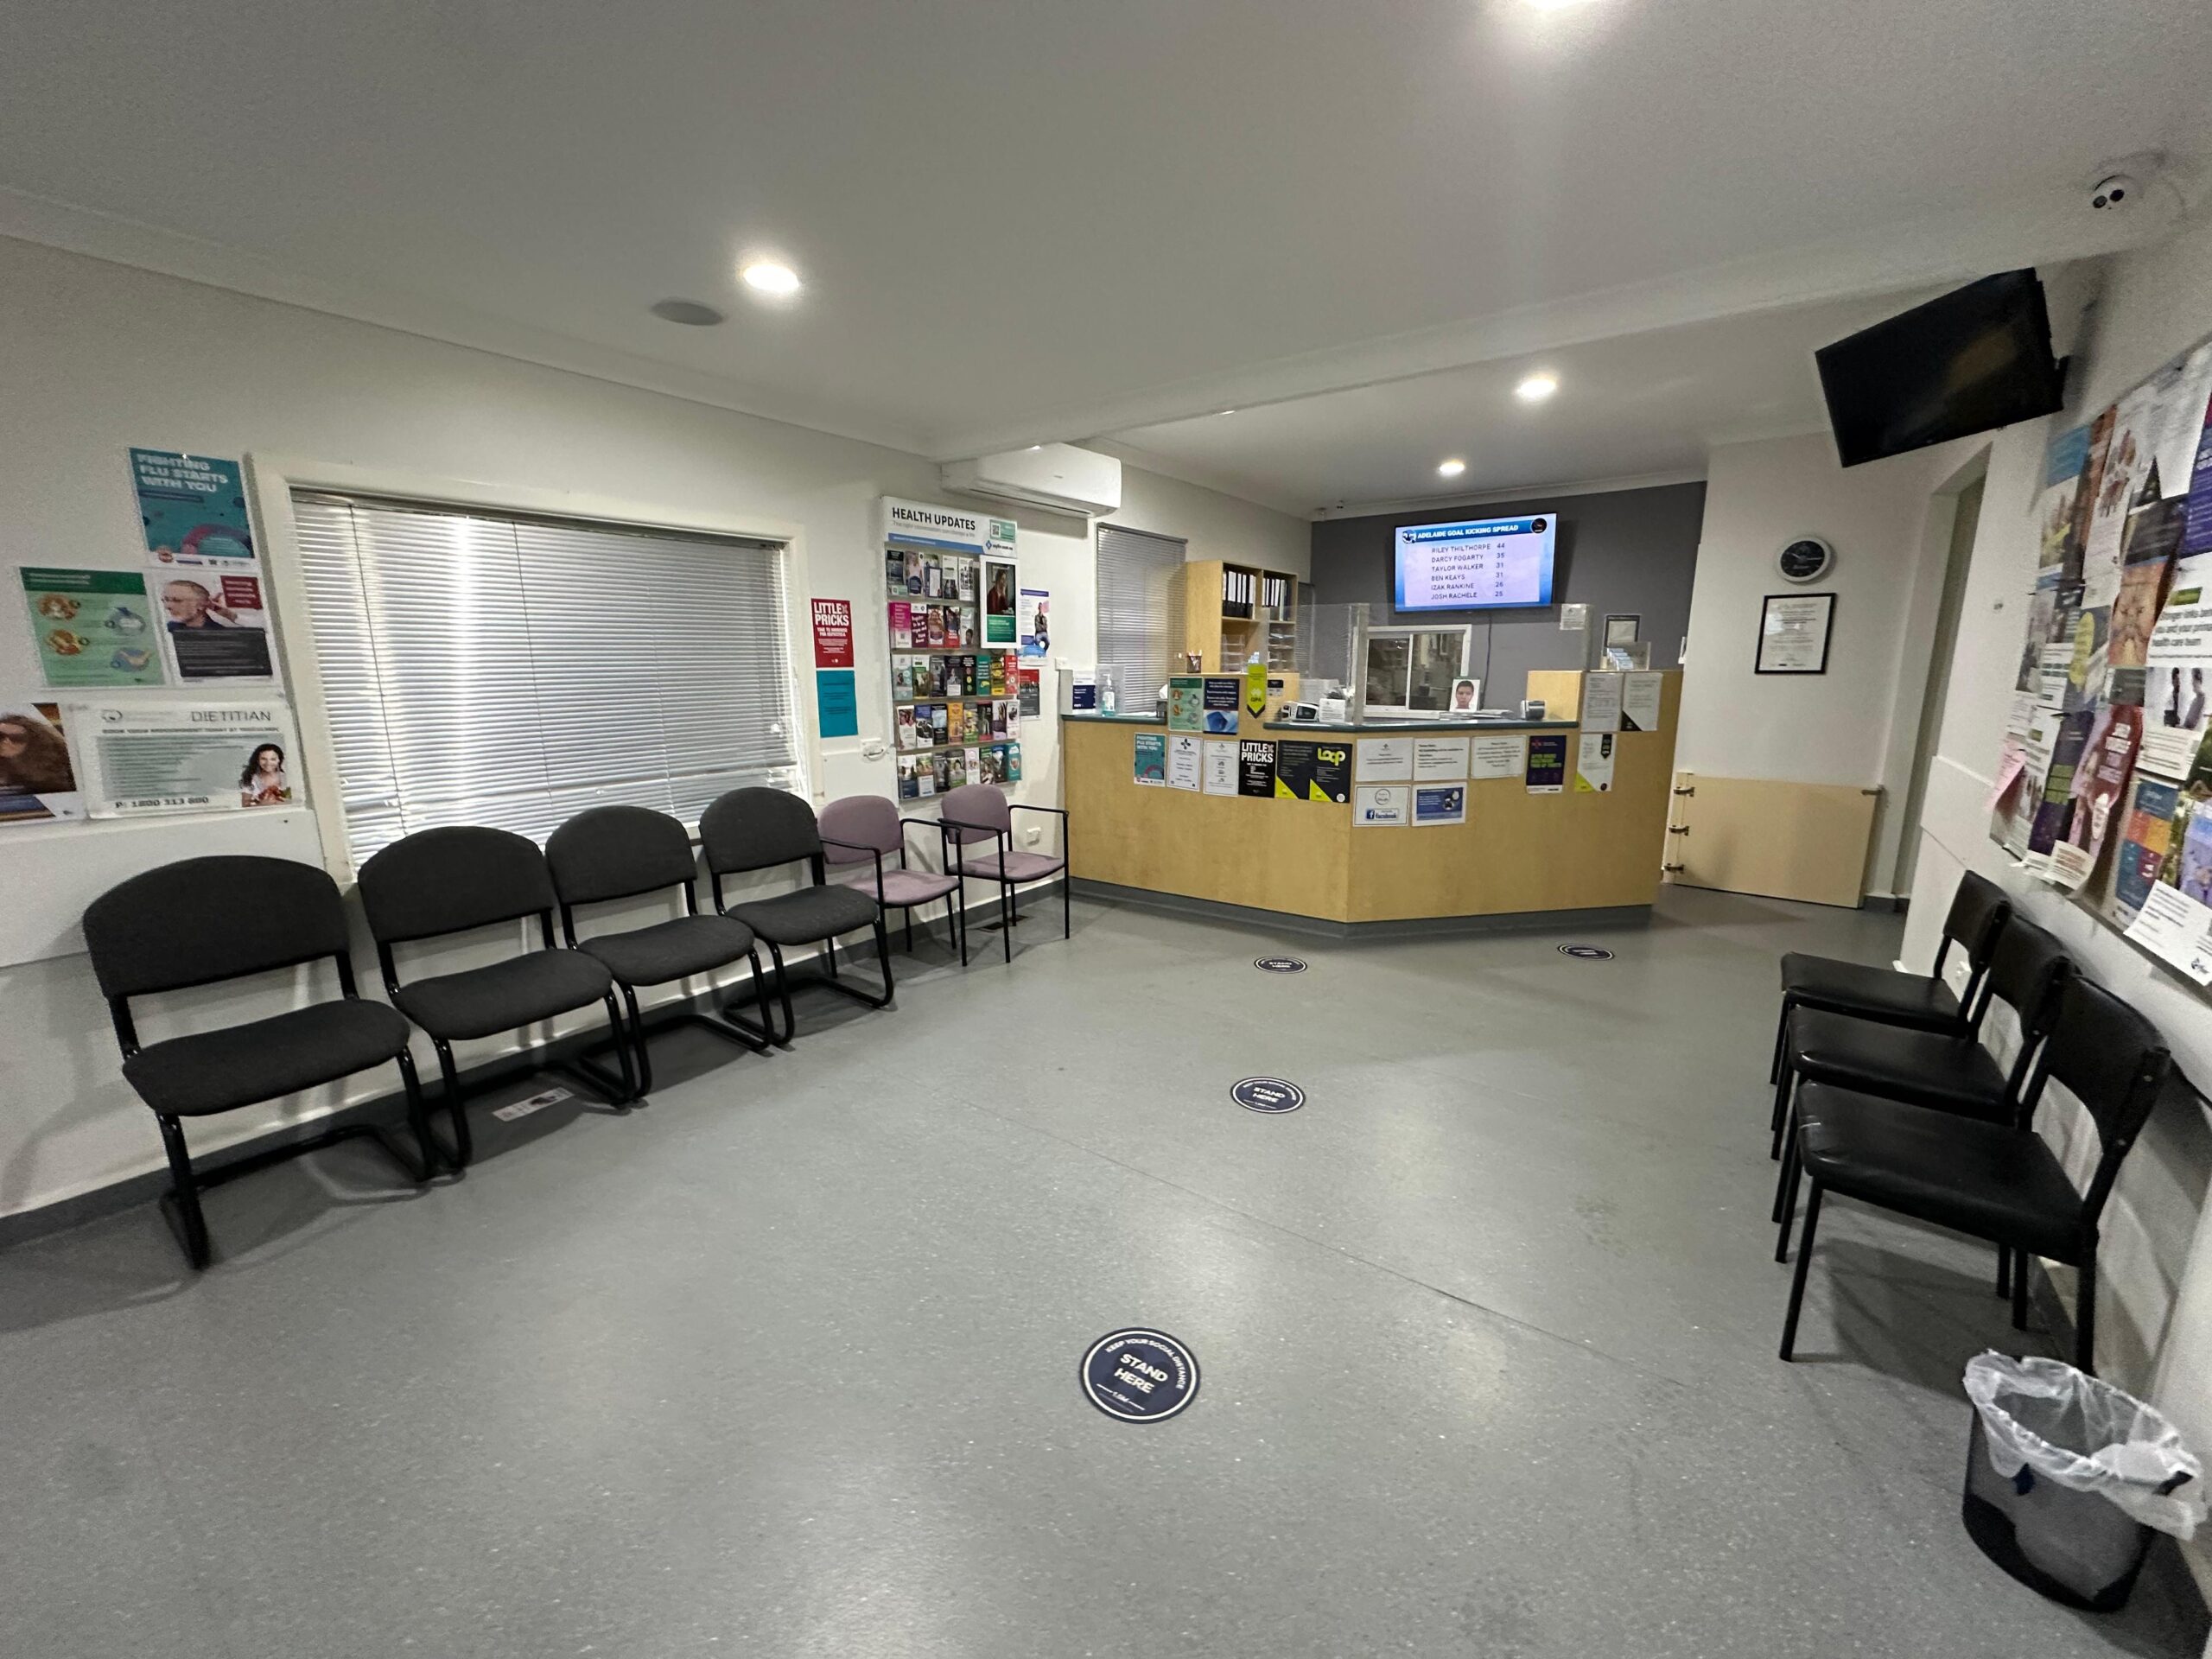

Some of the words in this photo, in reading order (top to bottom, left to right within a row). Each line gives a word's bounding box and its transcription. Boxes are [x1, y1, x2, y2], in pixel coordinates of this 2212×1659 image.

[140, 465, 169, 475] FLU
[173, 468, 228, 483] STARTS
[142, 476, 182, 489] WITH
[185, 480, 217, 493] YOU
[893, 507, 931, 523] HEALTH
[935, 515, 976, 530] UPDATES
[1452, 543, 1491, 552] THILTHORPE
[814, 602, 842, 614] LITTLE
[815, 614, 849, 626] PRICKS
[191, 710, 271, 722] DIETITIAN
[1242, 742, 1268, 753] LITTLE
[1241, 751, 1274, 763] PRICKS
[1252, 1093, 1279, 1103] HERE
[1254, 1087, 1286, 1098] STAND
[1120, 1353, 1168, 1382] STAND
[1148, 1340, 1174, 1357] SOCIAL
[1173, 1355, 1186, 1390] DISTANCE
[1114, 1368, 1155, 1394] HERE
